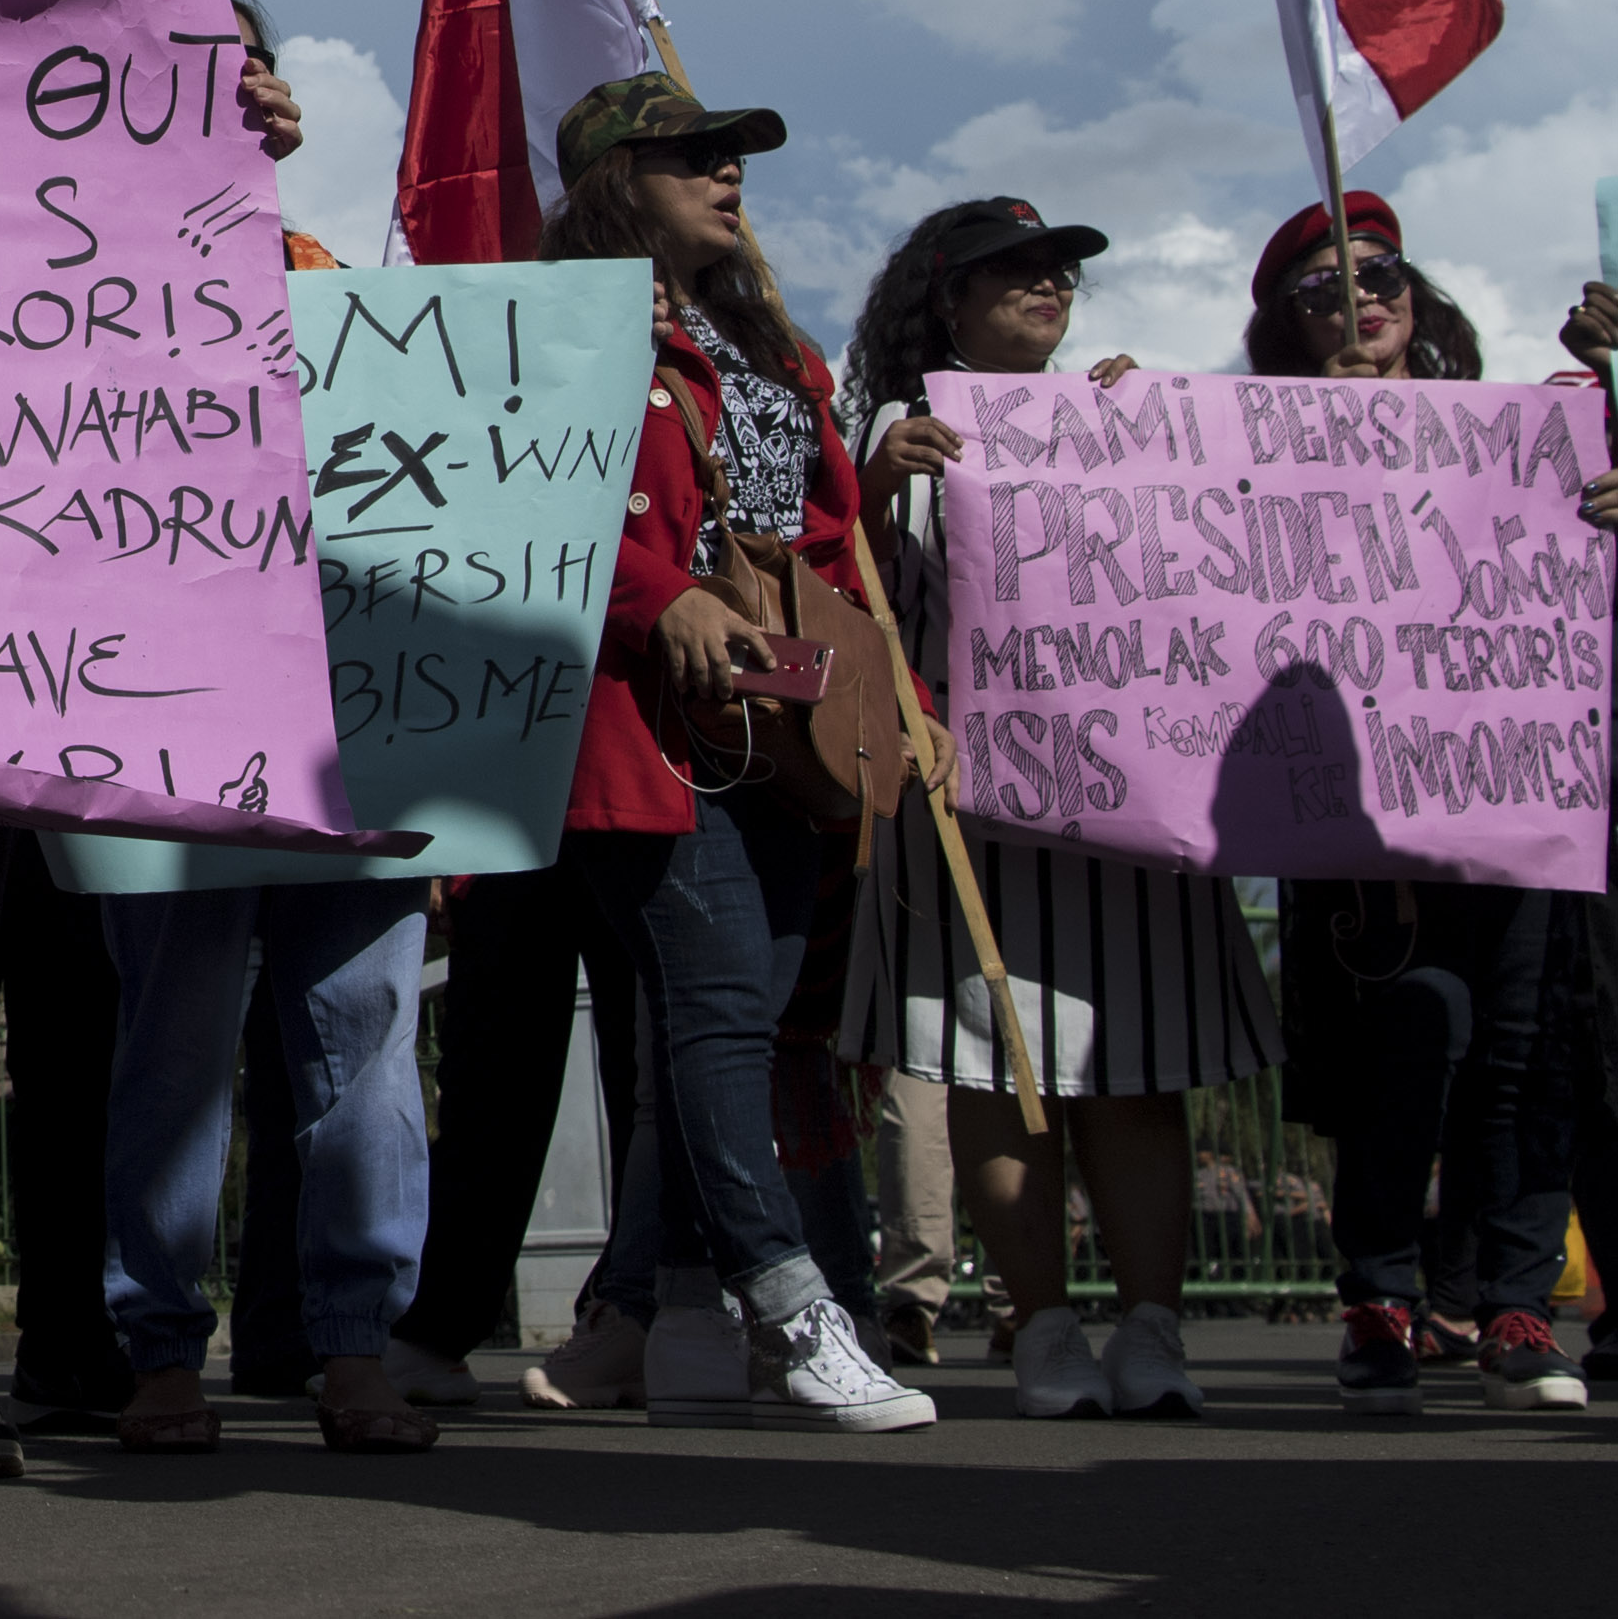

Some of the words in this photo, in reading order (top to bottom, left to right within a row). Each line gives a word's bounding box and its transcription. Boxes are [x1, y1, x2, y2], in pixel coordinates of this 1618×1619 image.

[25, 32, 240, 145] OUT
[1235, 382, 1583, 498] BERSAMA
[318, 539, 596, 633] BERSIH
[970, 617, 1231, 691] MENOLAK
[1254, 611, 1384, 690] 600
[1396, 618, 1604, 692] TERORIS
[1288, 764, 1348, 823] KE
